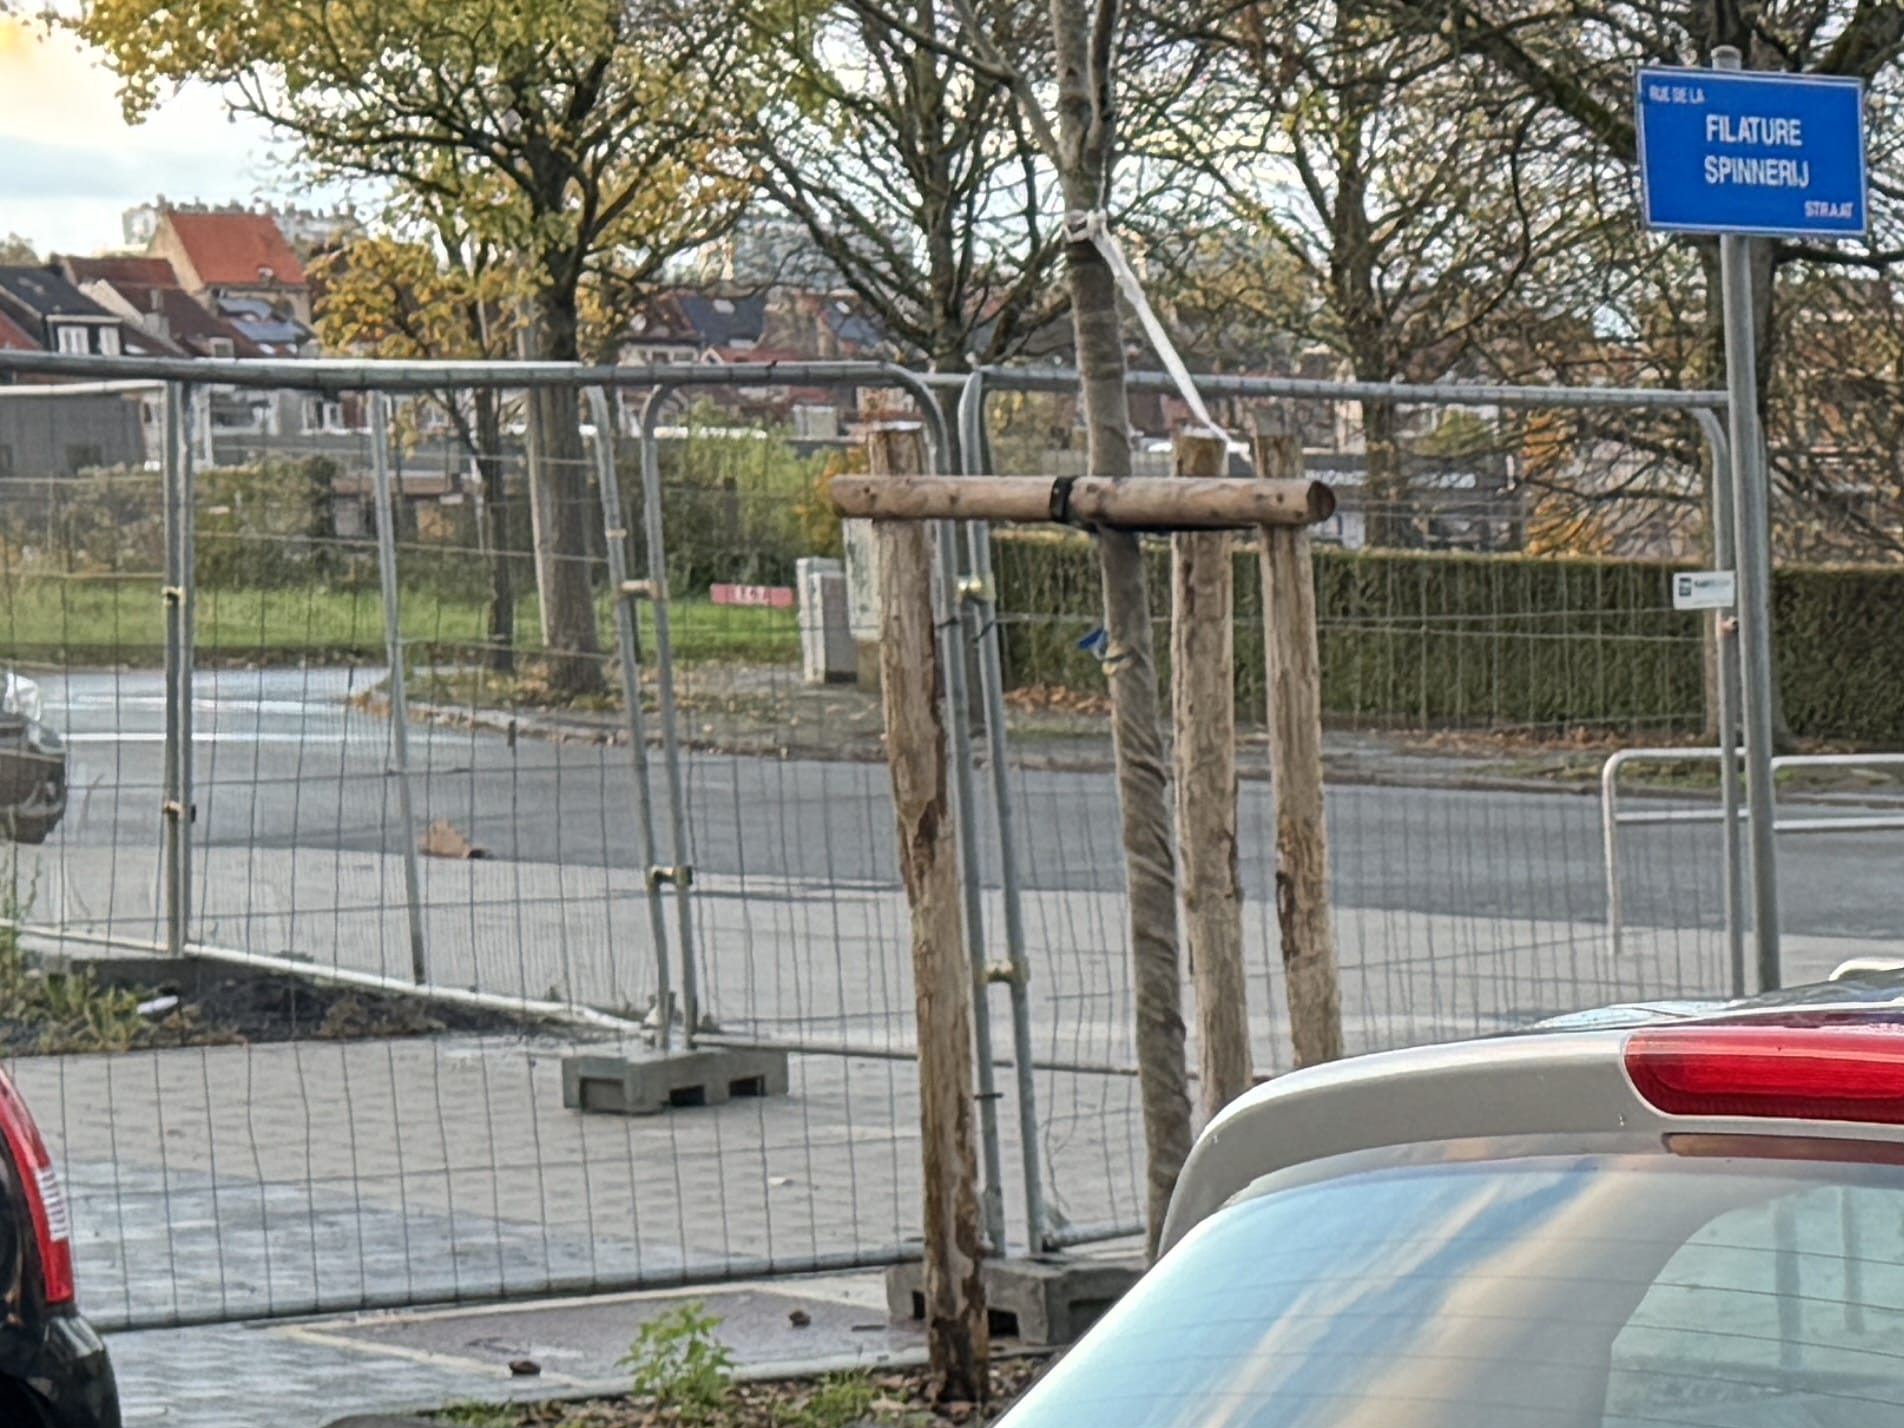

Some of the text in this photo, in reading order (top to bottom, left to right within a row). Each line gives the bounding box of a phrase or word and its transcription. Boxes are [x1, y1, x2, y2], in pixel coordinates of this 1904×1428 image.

[1672, 86, 1688, 104] DE
[1689, 87, 1705, 104] LA
[1706, 114, 1802, 146] FILATURE
[1704, 155, 1810, 188] SPINNERIJ
[1804, 200, 1854, 218] STRAAT
